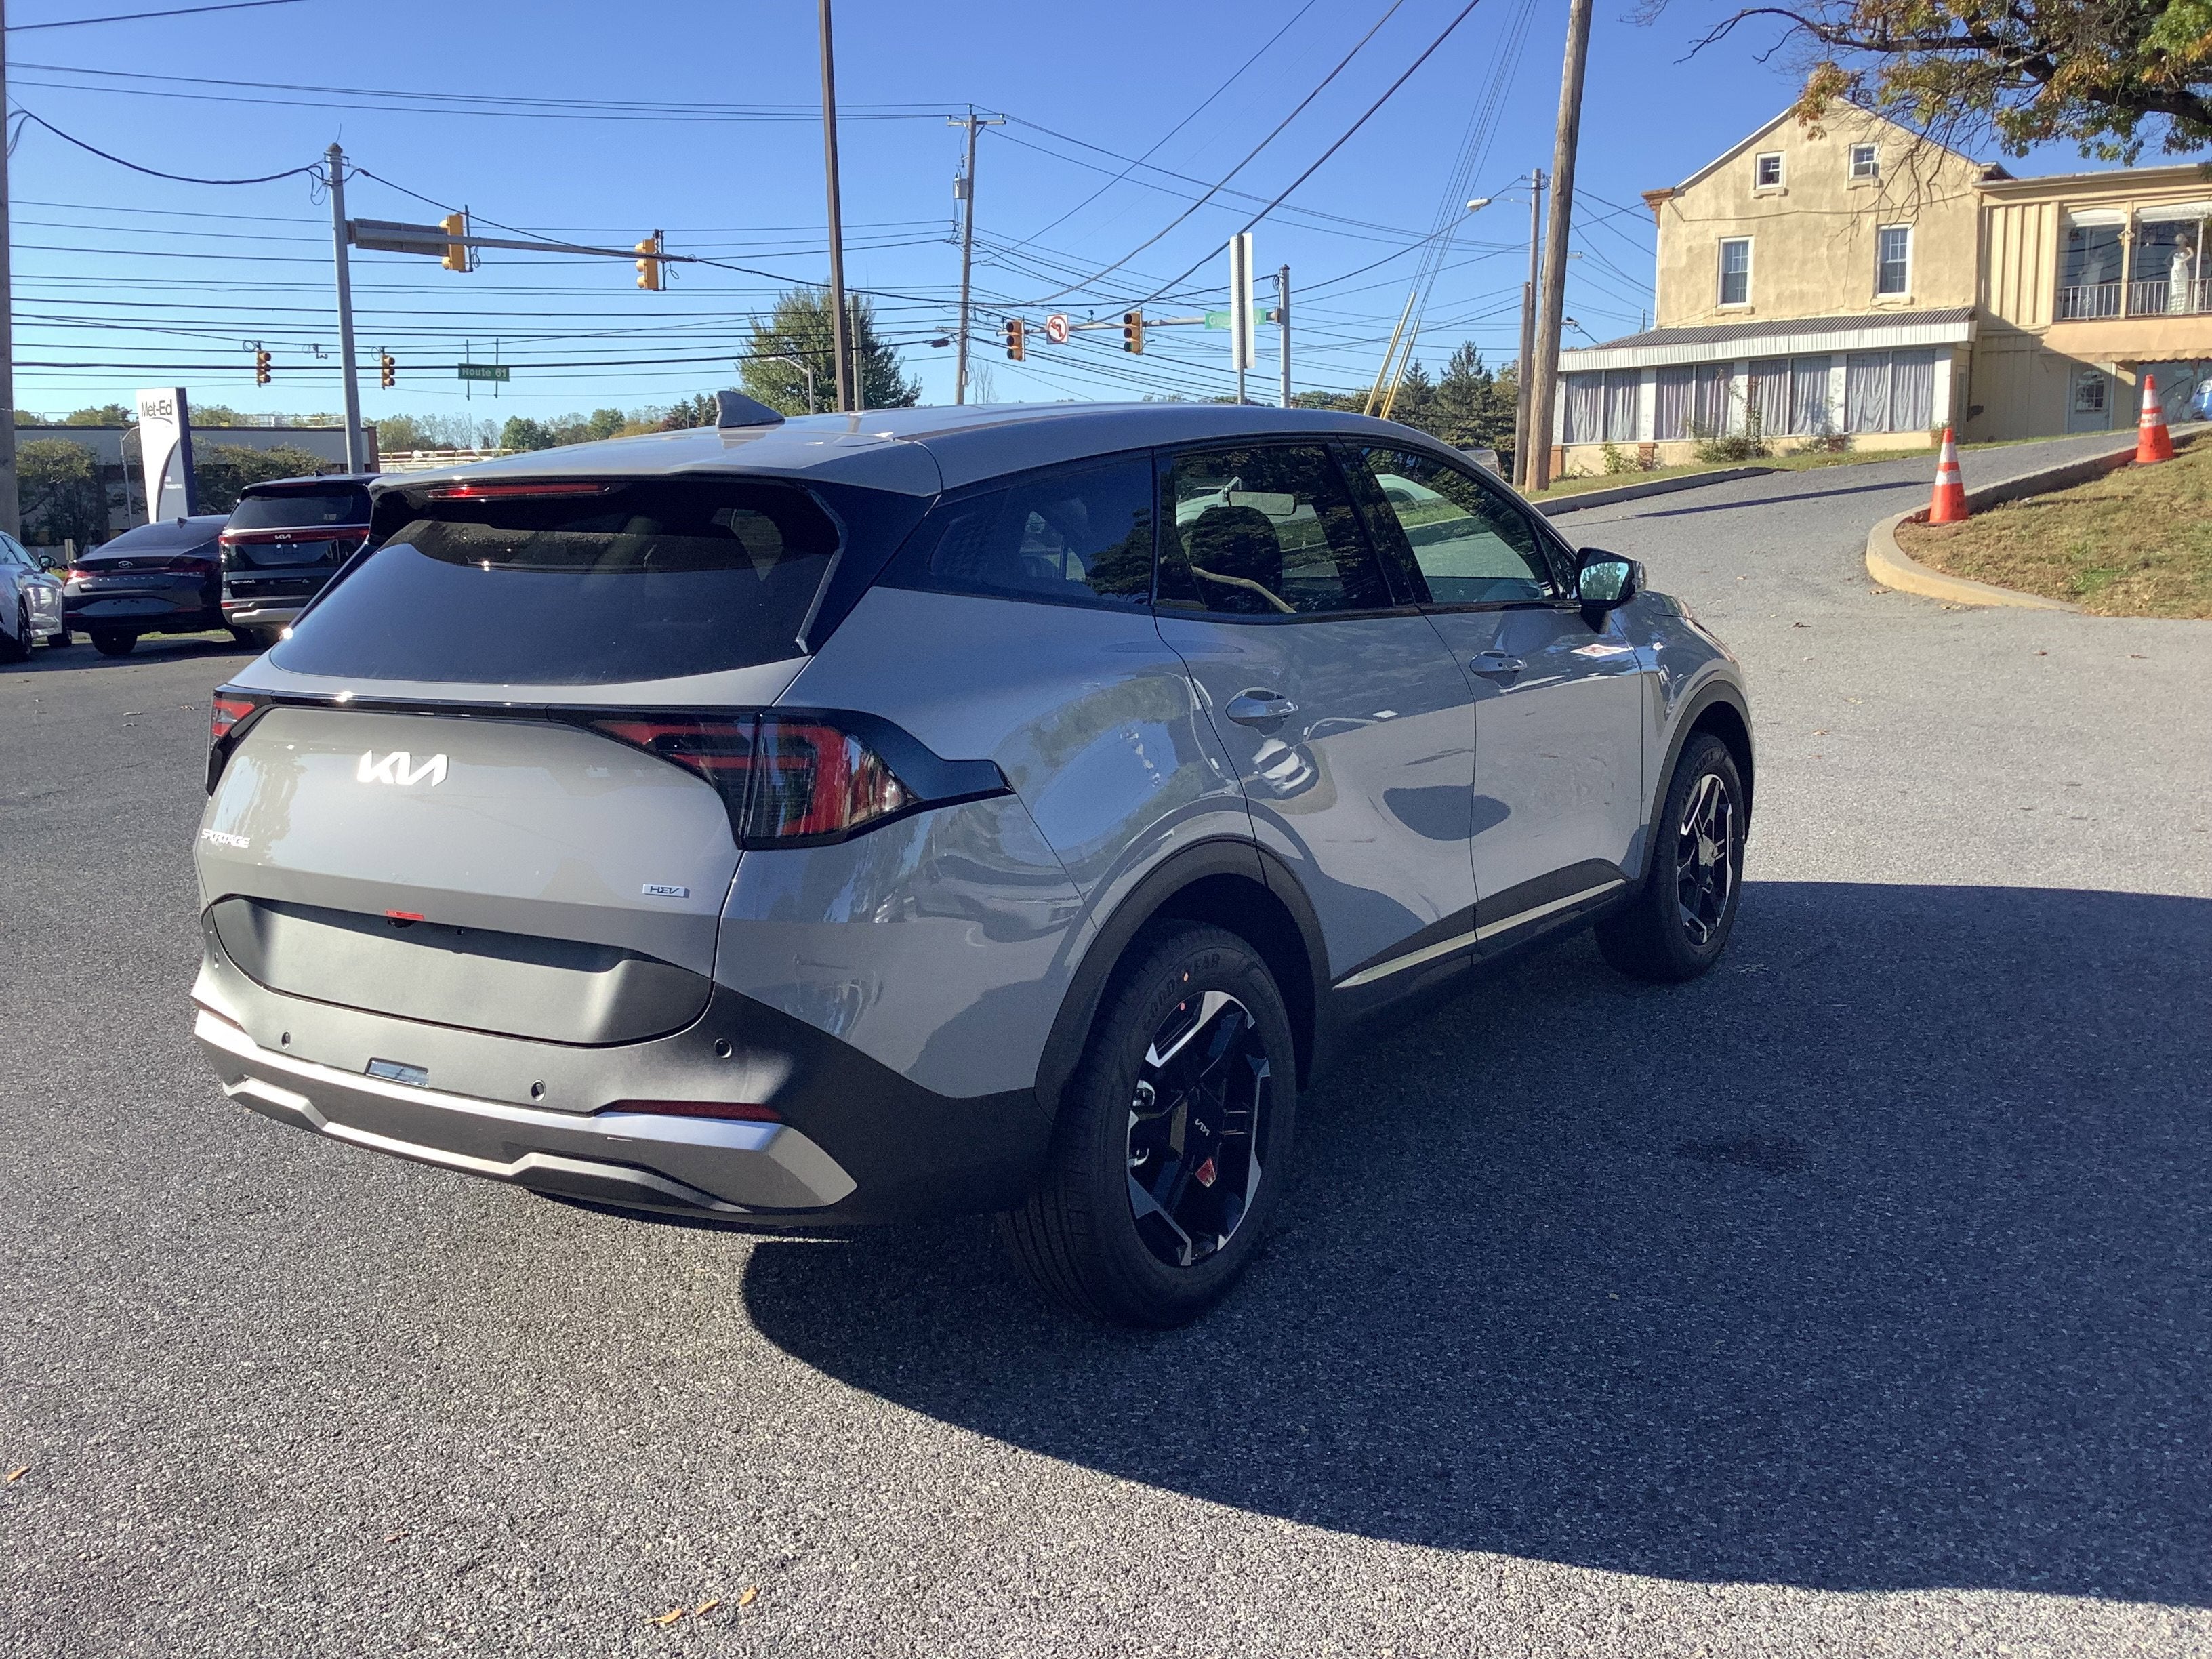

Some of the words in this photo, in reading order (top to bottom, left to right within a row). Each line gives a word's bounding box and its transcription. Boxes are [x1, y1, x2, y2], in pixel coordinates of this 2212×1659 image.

[462, 367, 491, 377] Route
[495, 367, 507, 377] 61
[141, 398, 173, 417] Met-Ed
[356, 749, 449, 787] KIA
[649, 886, 680, 895] HEV
